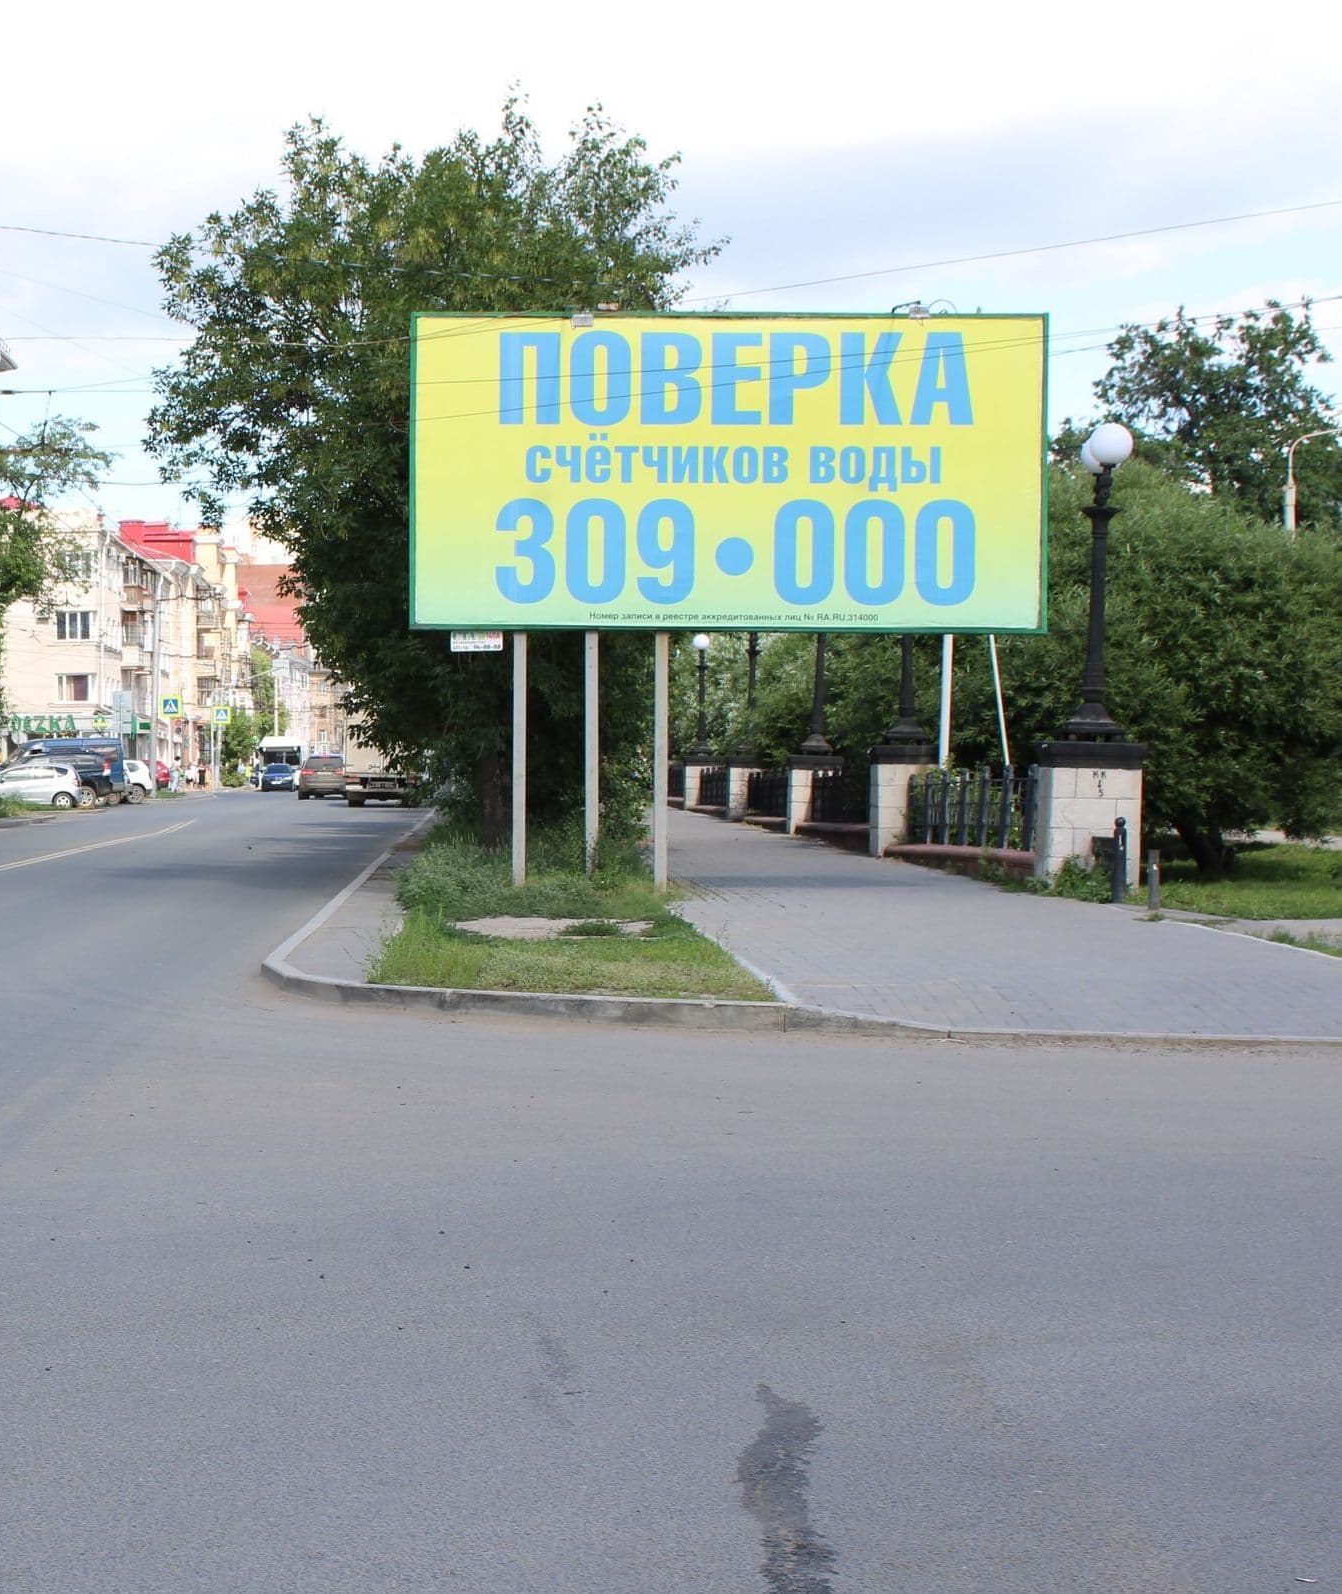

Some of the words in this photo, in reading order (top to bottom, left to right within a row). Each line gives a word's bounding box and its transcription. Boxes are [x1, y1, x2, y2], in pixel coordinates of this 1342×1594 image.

[499, 331, 974, 426] ПОВЕРКА
[525, 433, 789, 484] счётчиков
[809, 445, 942, 492] воды
[589, 611, 619, 622] Номер
[622, 612, 653, 621] записи
[663, 613, 699, 622] реестре
[701, 613, 783, 623] аккредитованных
[785, 614, 802, 623] лиц
[804, 612, 814, 621] №
